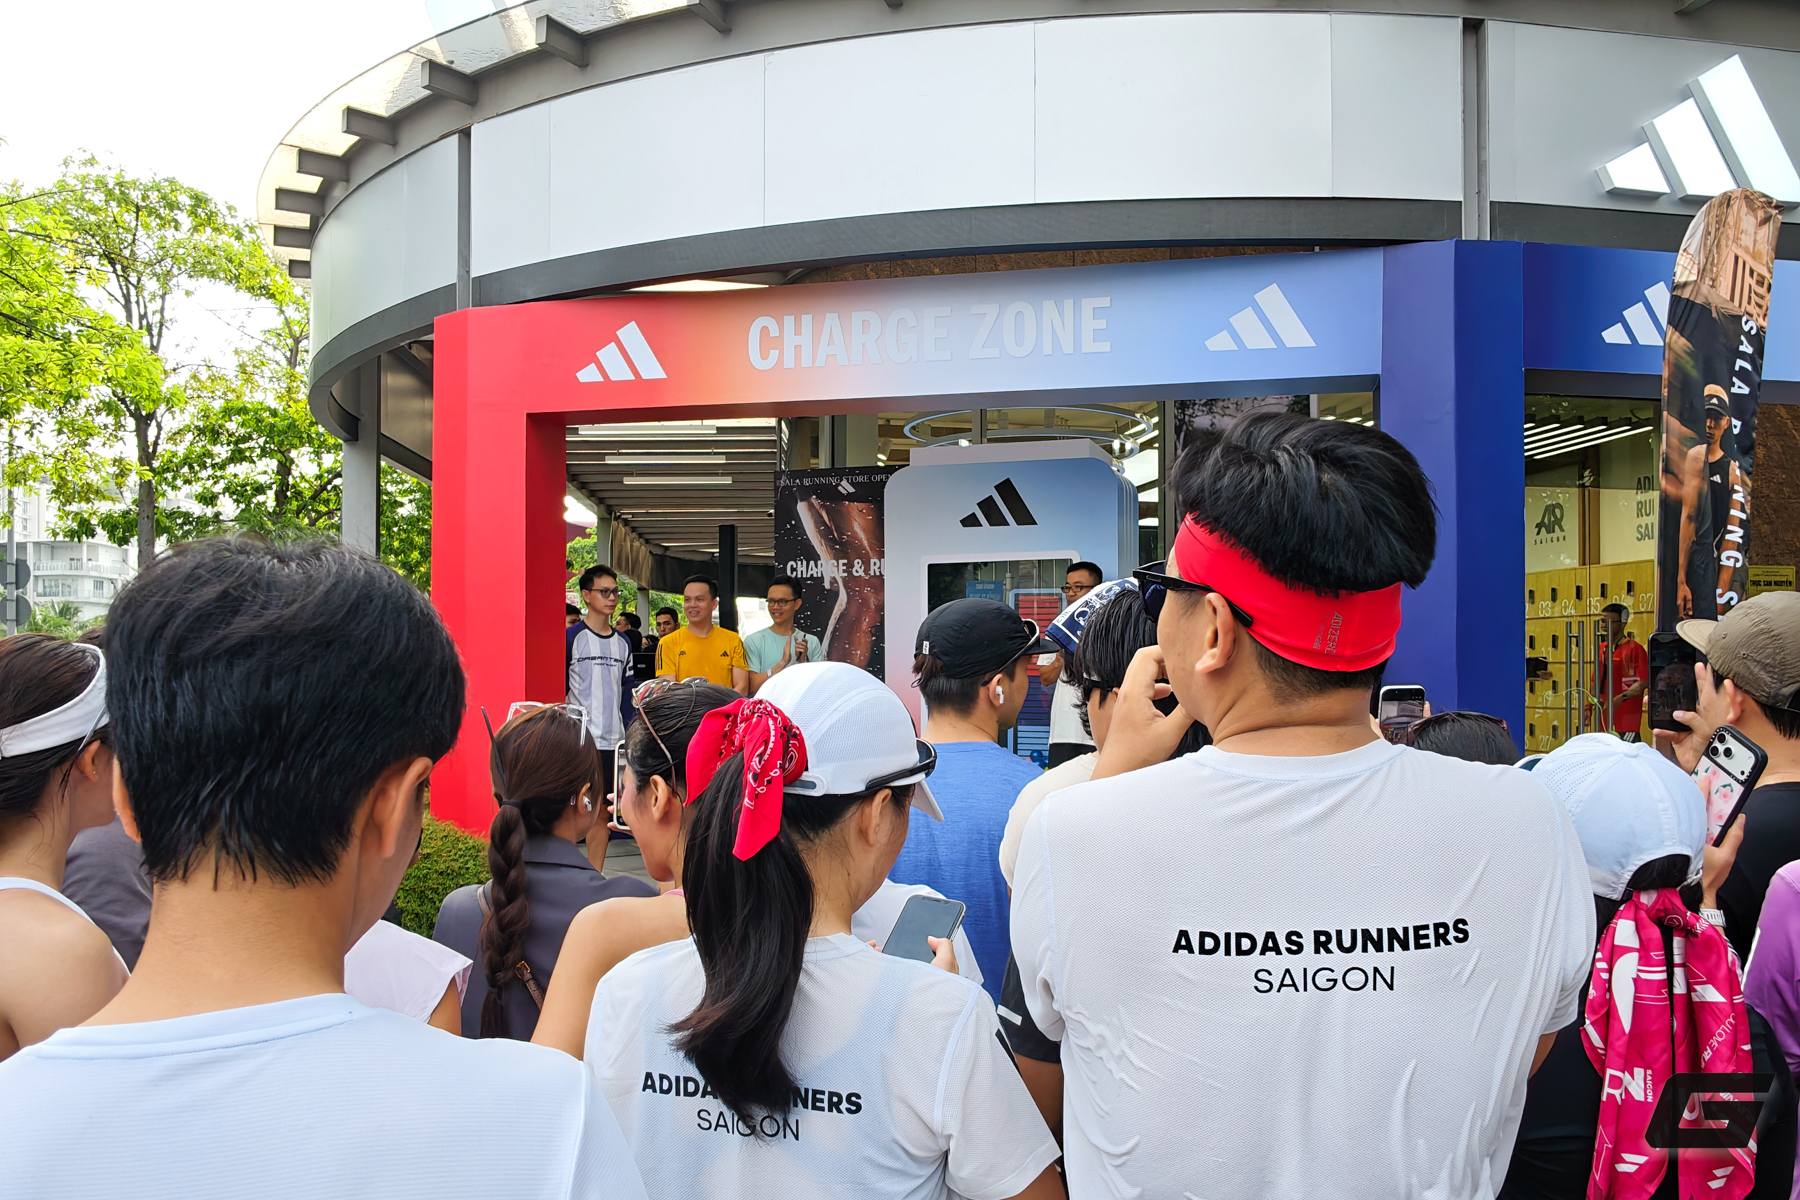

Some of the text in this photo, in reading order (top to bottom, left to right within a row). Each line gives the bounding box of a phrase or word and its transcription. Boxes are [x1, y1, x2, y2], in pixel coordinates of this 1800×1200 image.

[748, 296, 1113, 371] CHARGE ZONE
[1731, 315, 1758, 395] SALA
[780, 478, 801, 487] SALA
[803, 476, 841, 486] RUNNING
[842, 474, 870, 483] STORE
[786, 559, 848, 578] CHARGE
[852, 558, 866, 577] &
[1538, 601, 1551, 617] 03
[1562, 599, 1576, 616] 04
[1587, 597, 1601, 614] 05
[1639, 593, 1654, 611] 07
[1172, 917, 1470, 957] ADIDAS RUNNERS
[1253, 966, 1395, 994] SAIGON
[642, 1071, 720, 1101] ADIDA
[1645, 1069, 1654, 1103] SAIGON
[696, 1108, 800, 1142] SAIGON
